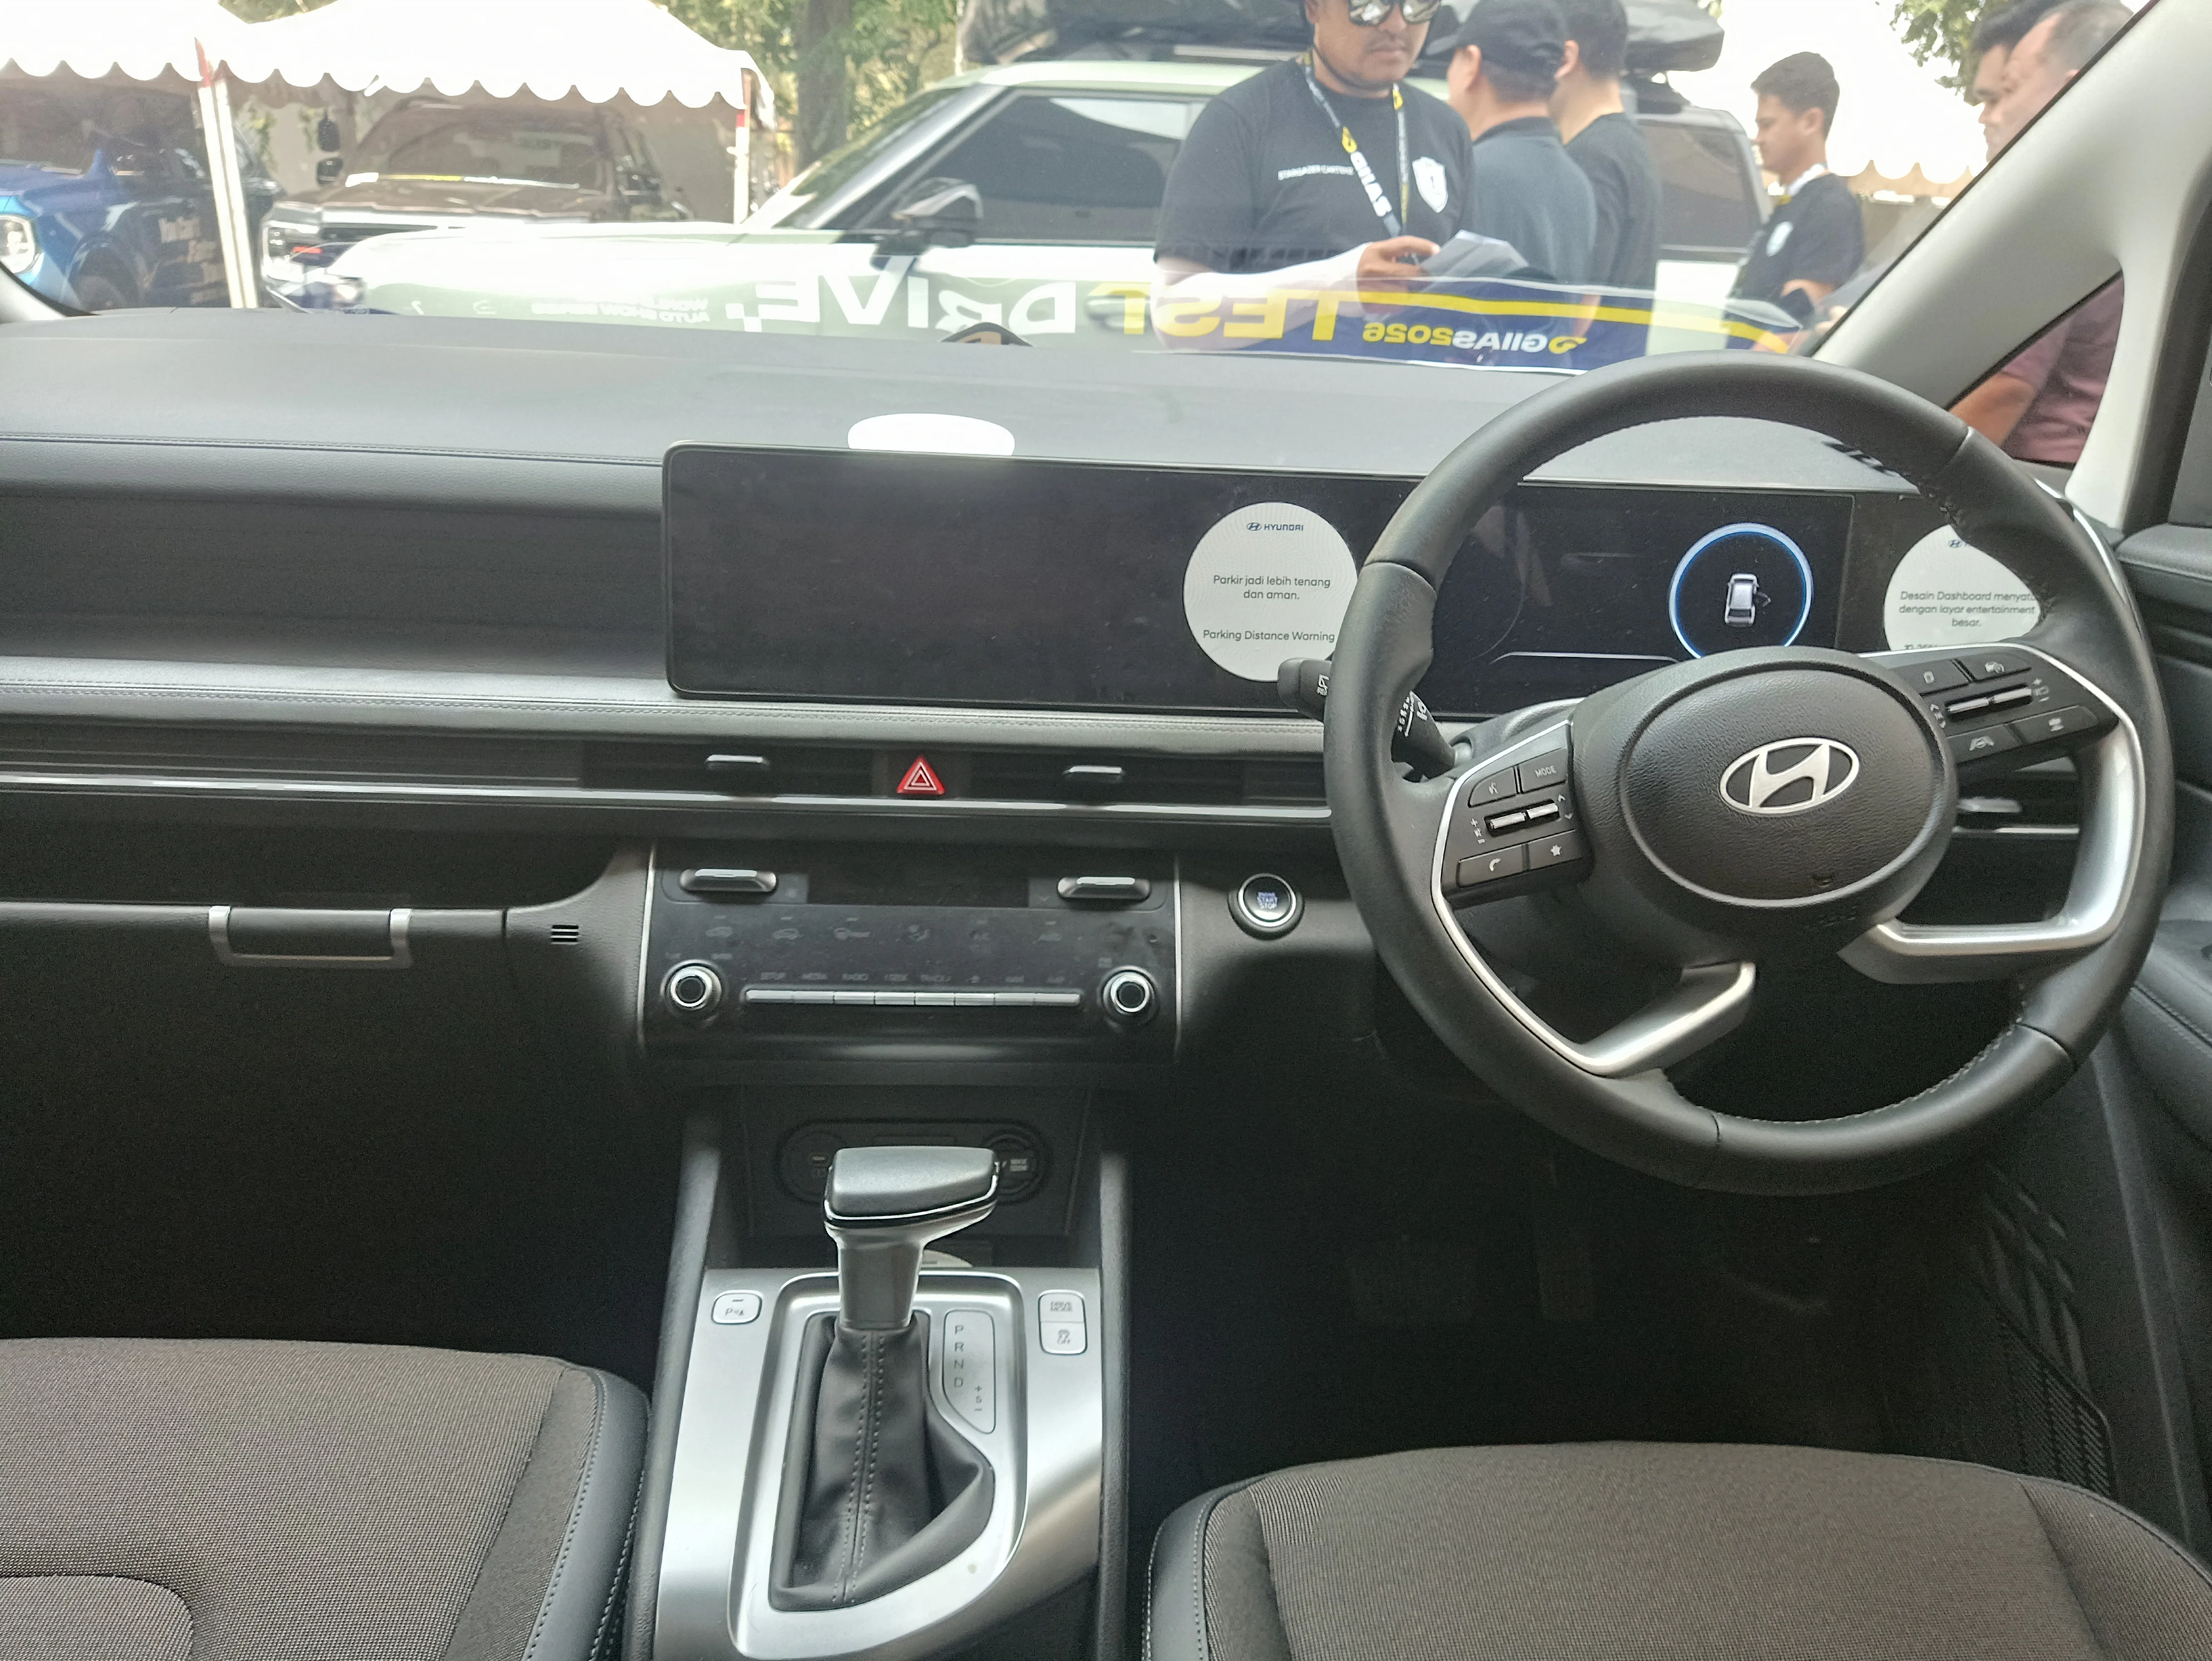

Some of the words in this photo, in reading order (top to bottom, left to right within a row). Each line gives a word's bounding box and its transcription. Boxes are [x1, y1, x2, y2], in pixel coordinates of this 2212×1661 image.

[1213, 575, 1243, 585] Parkir
[1245, 576, 1264, 587] jadi
[1267, 576, 1291, 586] lebih
[1294, 577, 1330, 588] tenang
[1243, 589, 1263, 599] dan
[1266, 591, 1299, 599] aman.
[1900, 591, 1934, 600] Desain
[1936, 591, 1991, 601] Dashboard
[1899, 605, 1937, 615] dengan
[1939, 605, 1964, 615] layar
[1966, 606, 2035, 614] entertainment
[1952, 618, 1981, 627] besar.
[1203, 630, 1241, 641] Parking
[1245, 631, 1289, 640] Distance
[1292, 631, 1335, 643] Warning
[1535, 765, 1557, 777] MODE
[955, 1325, 964, 1335] P
[954, 1342, 964, 1352] R
[954, 1358, 964, 1369] N
[954, 1377, 964, 1388] D
